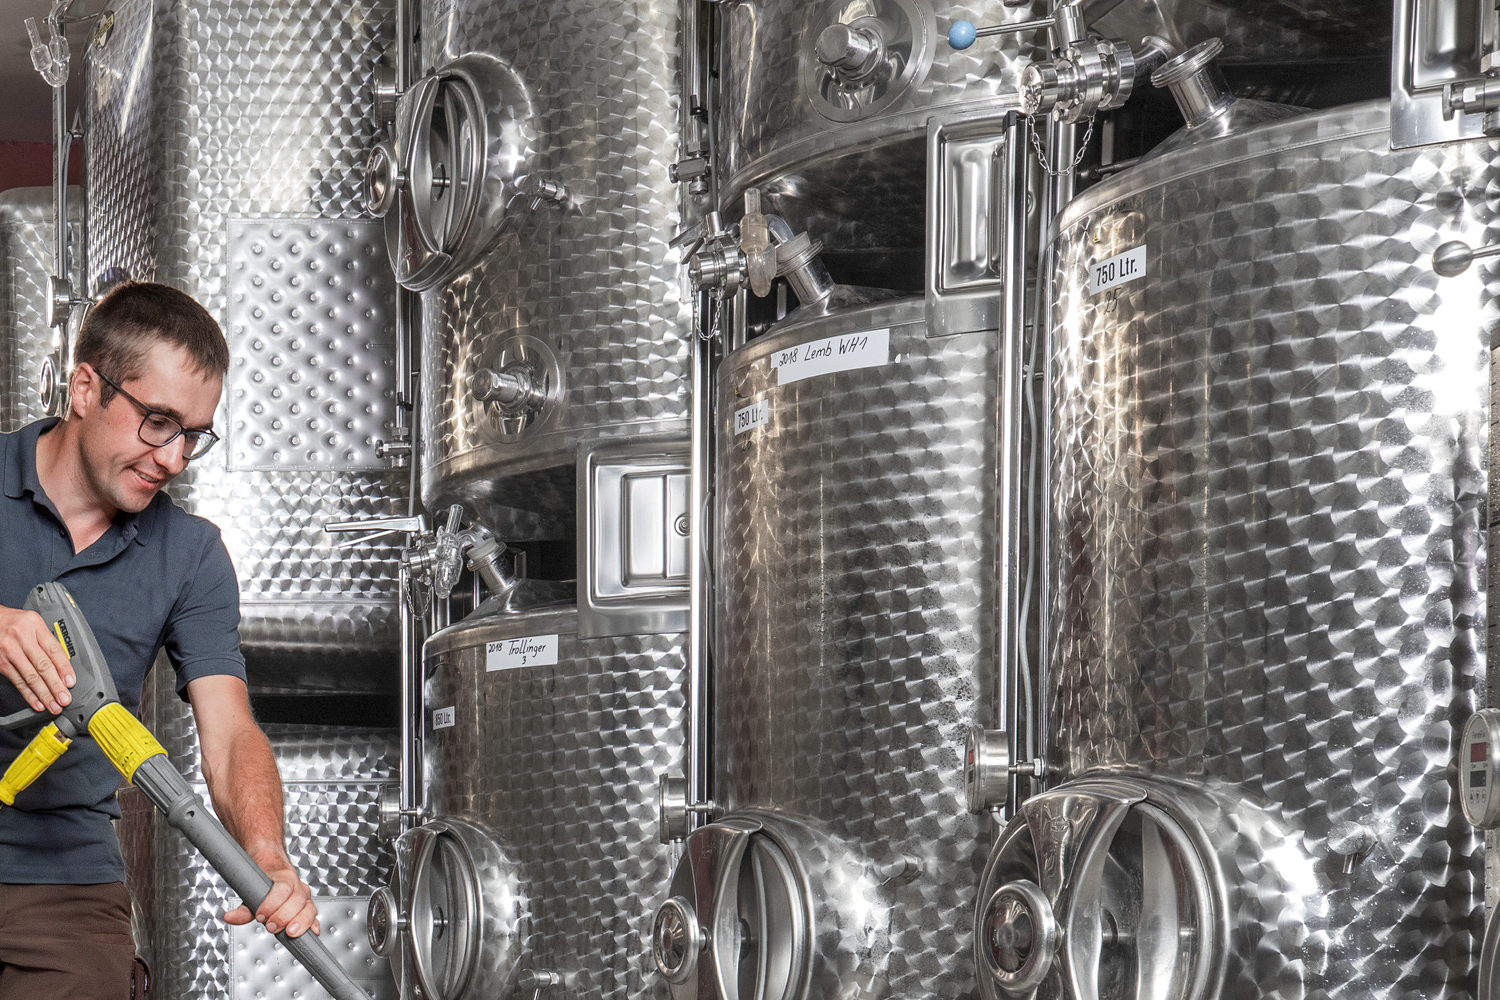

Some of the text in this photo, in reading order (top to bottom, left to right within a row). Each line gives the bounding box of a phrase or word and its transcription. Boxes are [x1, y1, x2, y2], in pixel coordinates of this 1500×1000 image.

[1096, 257, 1138, 287] 750 Ltr.
[778, 348, 799, 367] 2018
[804, 341, 832, 362] Lemb
[737, 409, 764, 429] 750 Ltr.
[57, 618, 76, 658] KÄRCHER
[488, 638, 547, 658] 2018 Trollinger
[521, 655, 527, 665] 3
